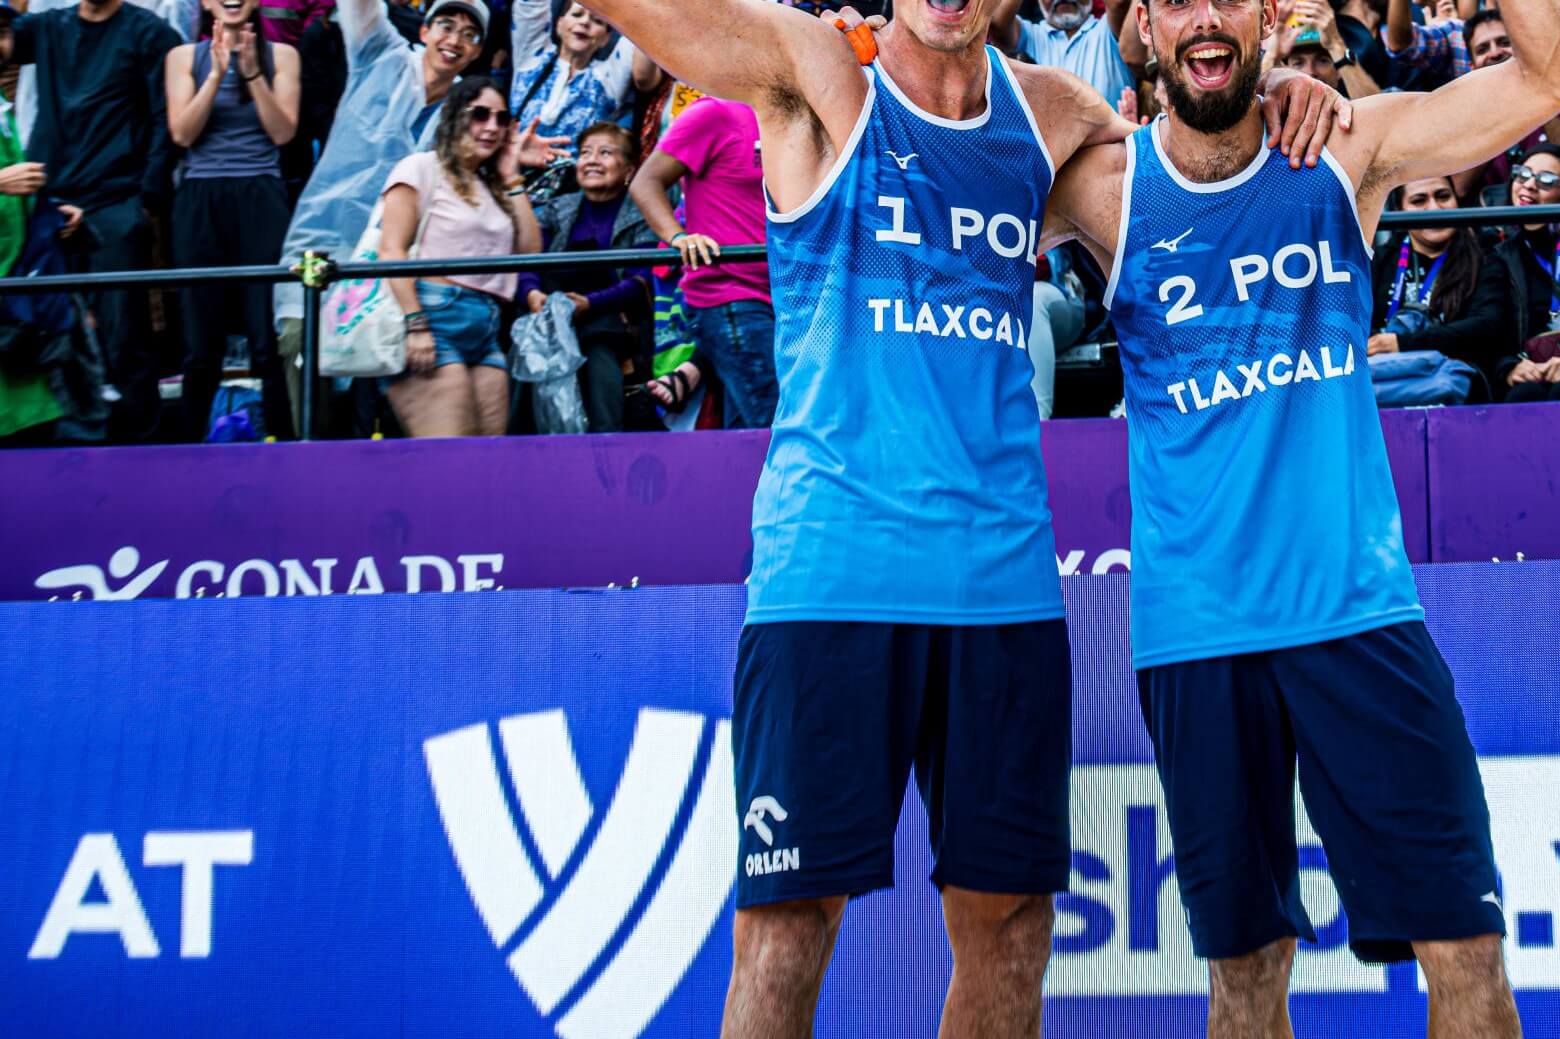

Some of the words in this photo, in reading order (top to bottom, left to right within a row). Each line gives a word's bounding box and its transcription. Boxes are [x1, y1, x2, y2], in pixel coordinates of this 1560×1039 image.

[876, 195, 921, 245] 1
[1158, 275, 1204, 326] 2
[1230, 240, 1350, 302] POL
[27, 829, 254, 959] AT
[745, 846, 800, 878] ORLEN
